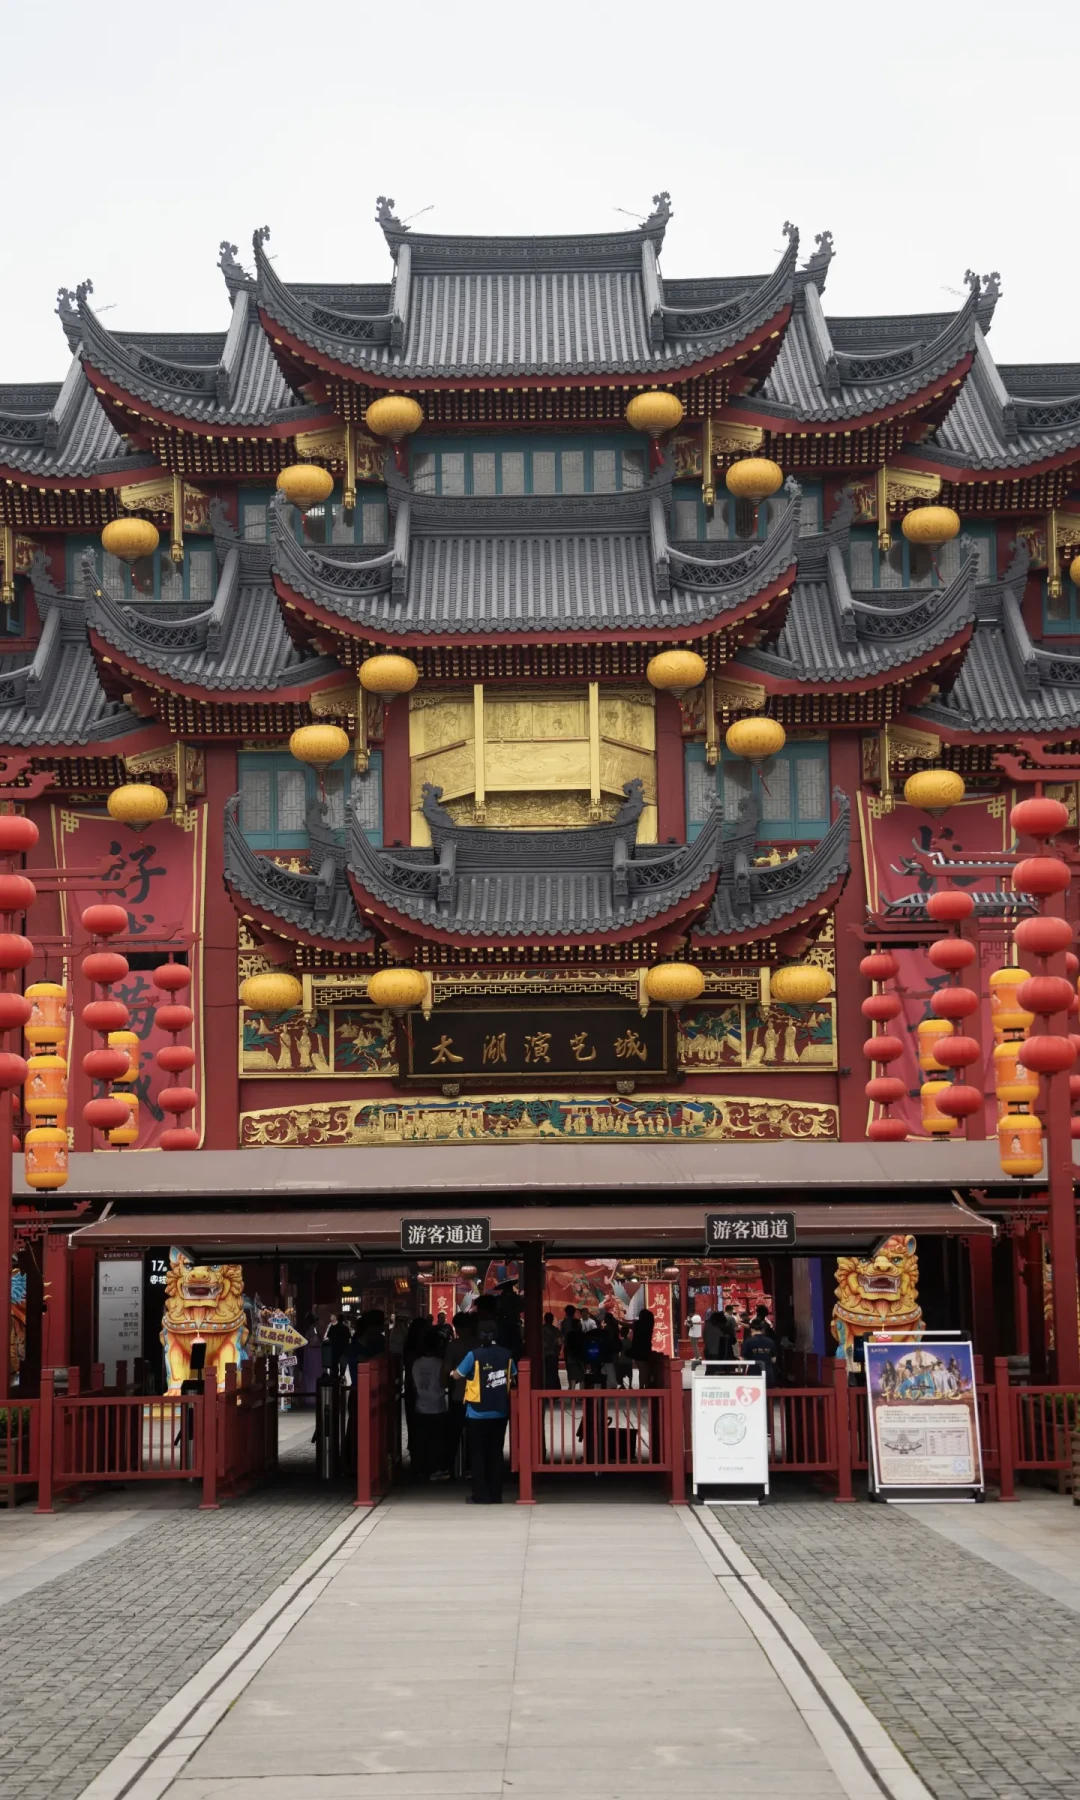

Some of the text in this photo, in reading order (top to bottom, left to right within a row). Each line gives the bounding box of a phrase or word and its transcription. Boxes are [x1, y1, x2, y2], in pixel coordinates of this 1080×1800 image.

[429, 1028, 648, 1065] 太湖演艺城
[407, 1224, 484, 1245] 游客通道
[713, 1219, 789, 1240] 游客通道
[260, 1328, 303, 1346] 礼品兑换处
